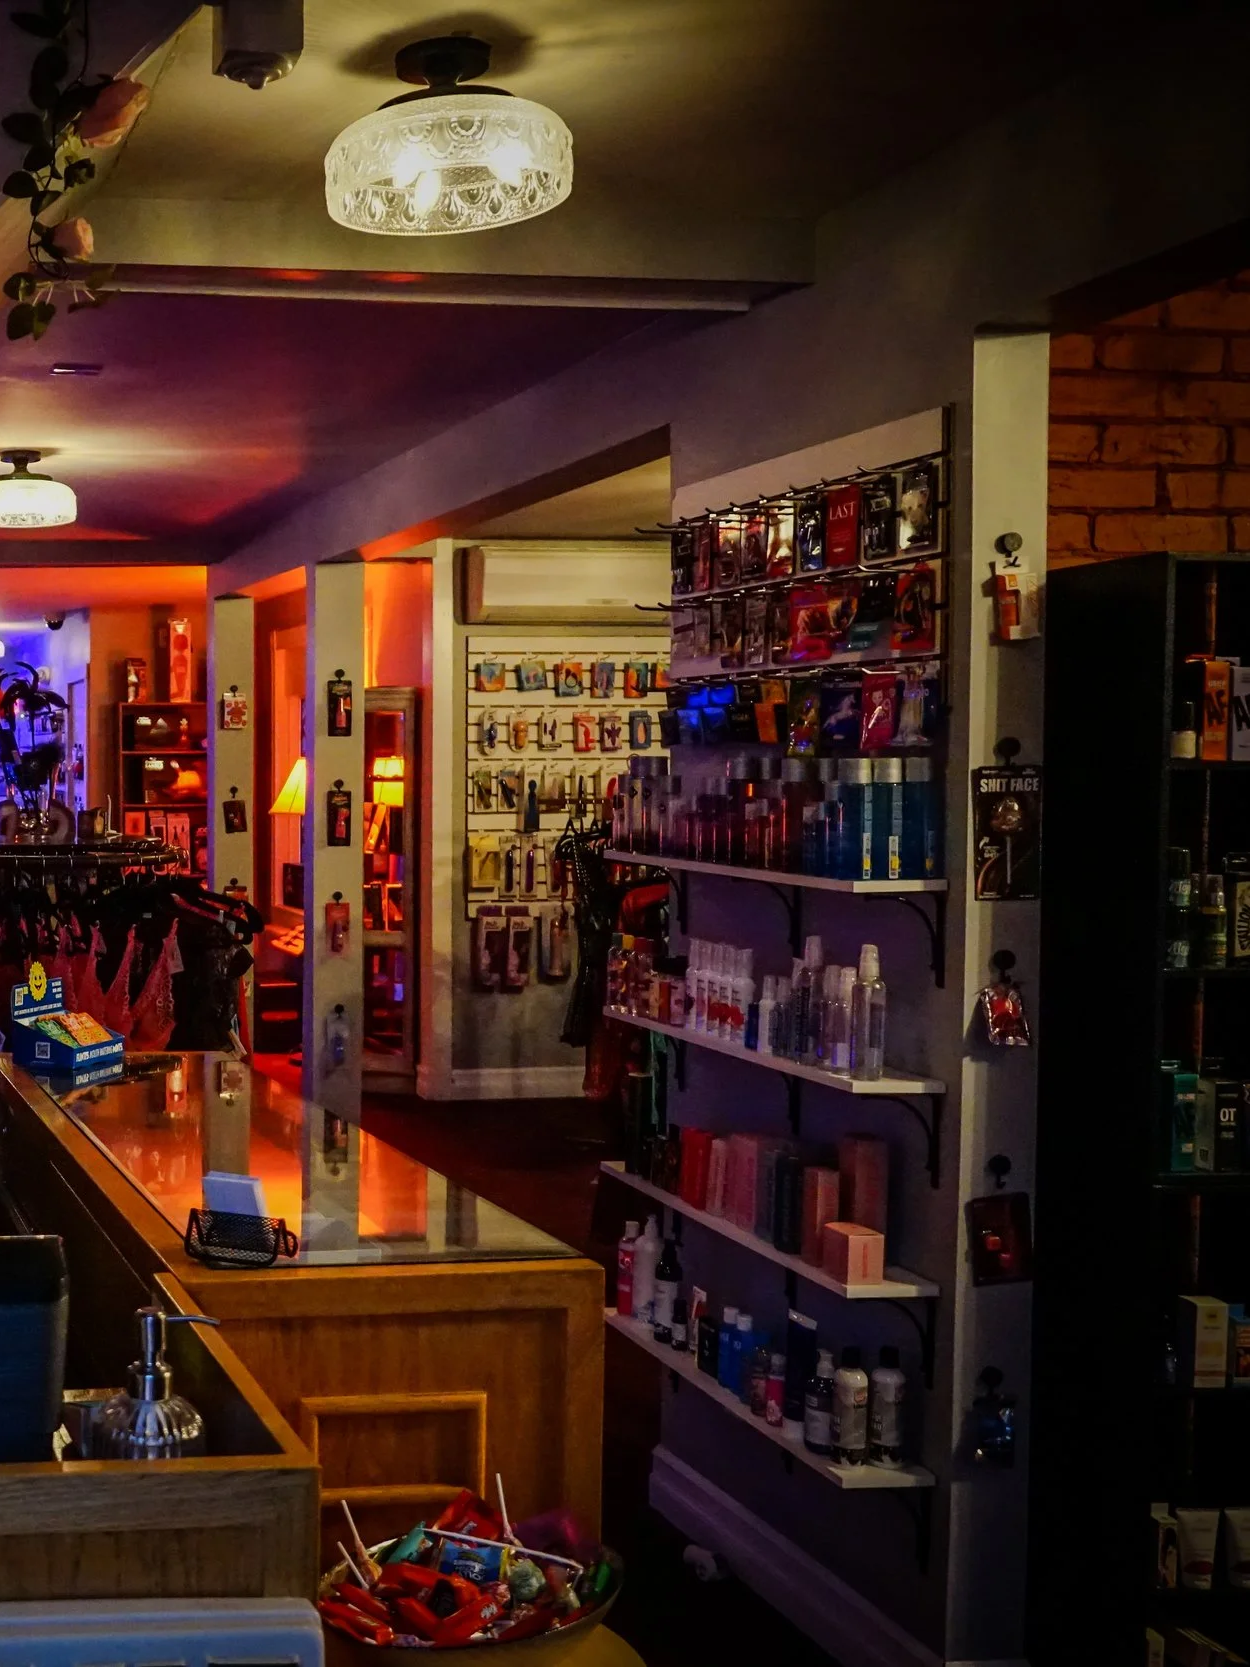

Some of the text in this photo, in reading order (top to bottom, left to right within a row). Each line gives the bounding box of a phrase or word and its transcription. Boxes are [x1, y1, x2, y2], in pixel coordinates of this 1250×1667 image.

[829, 500, 857, 521] LAST
[979, 777, 1039, 793] SHIT FACE
